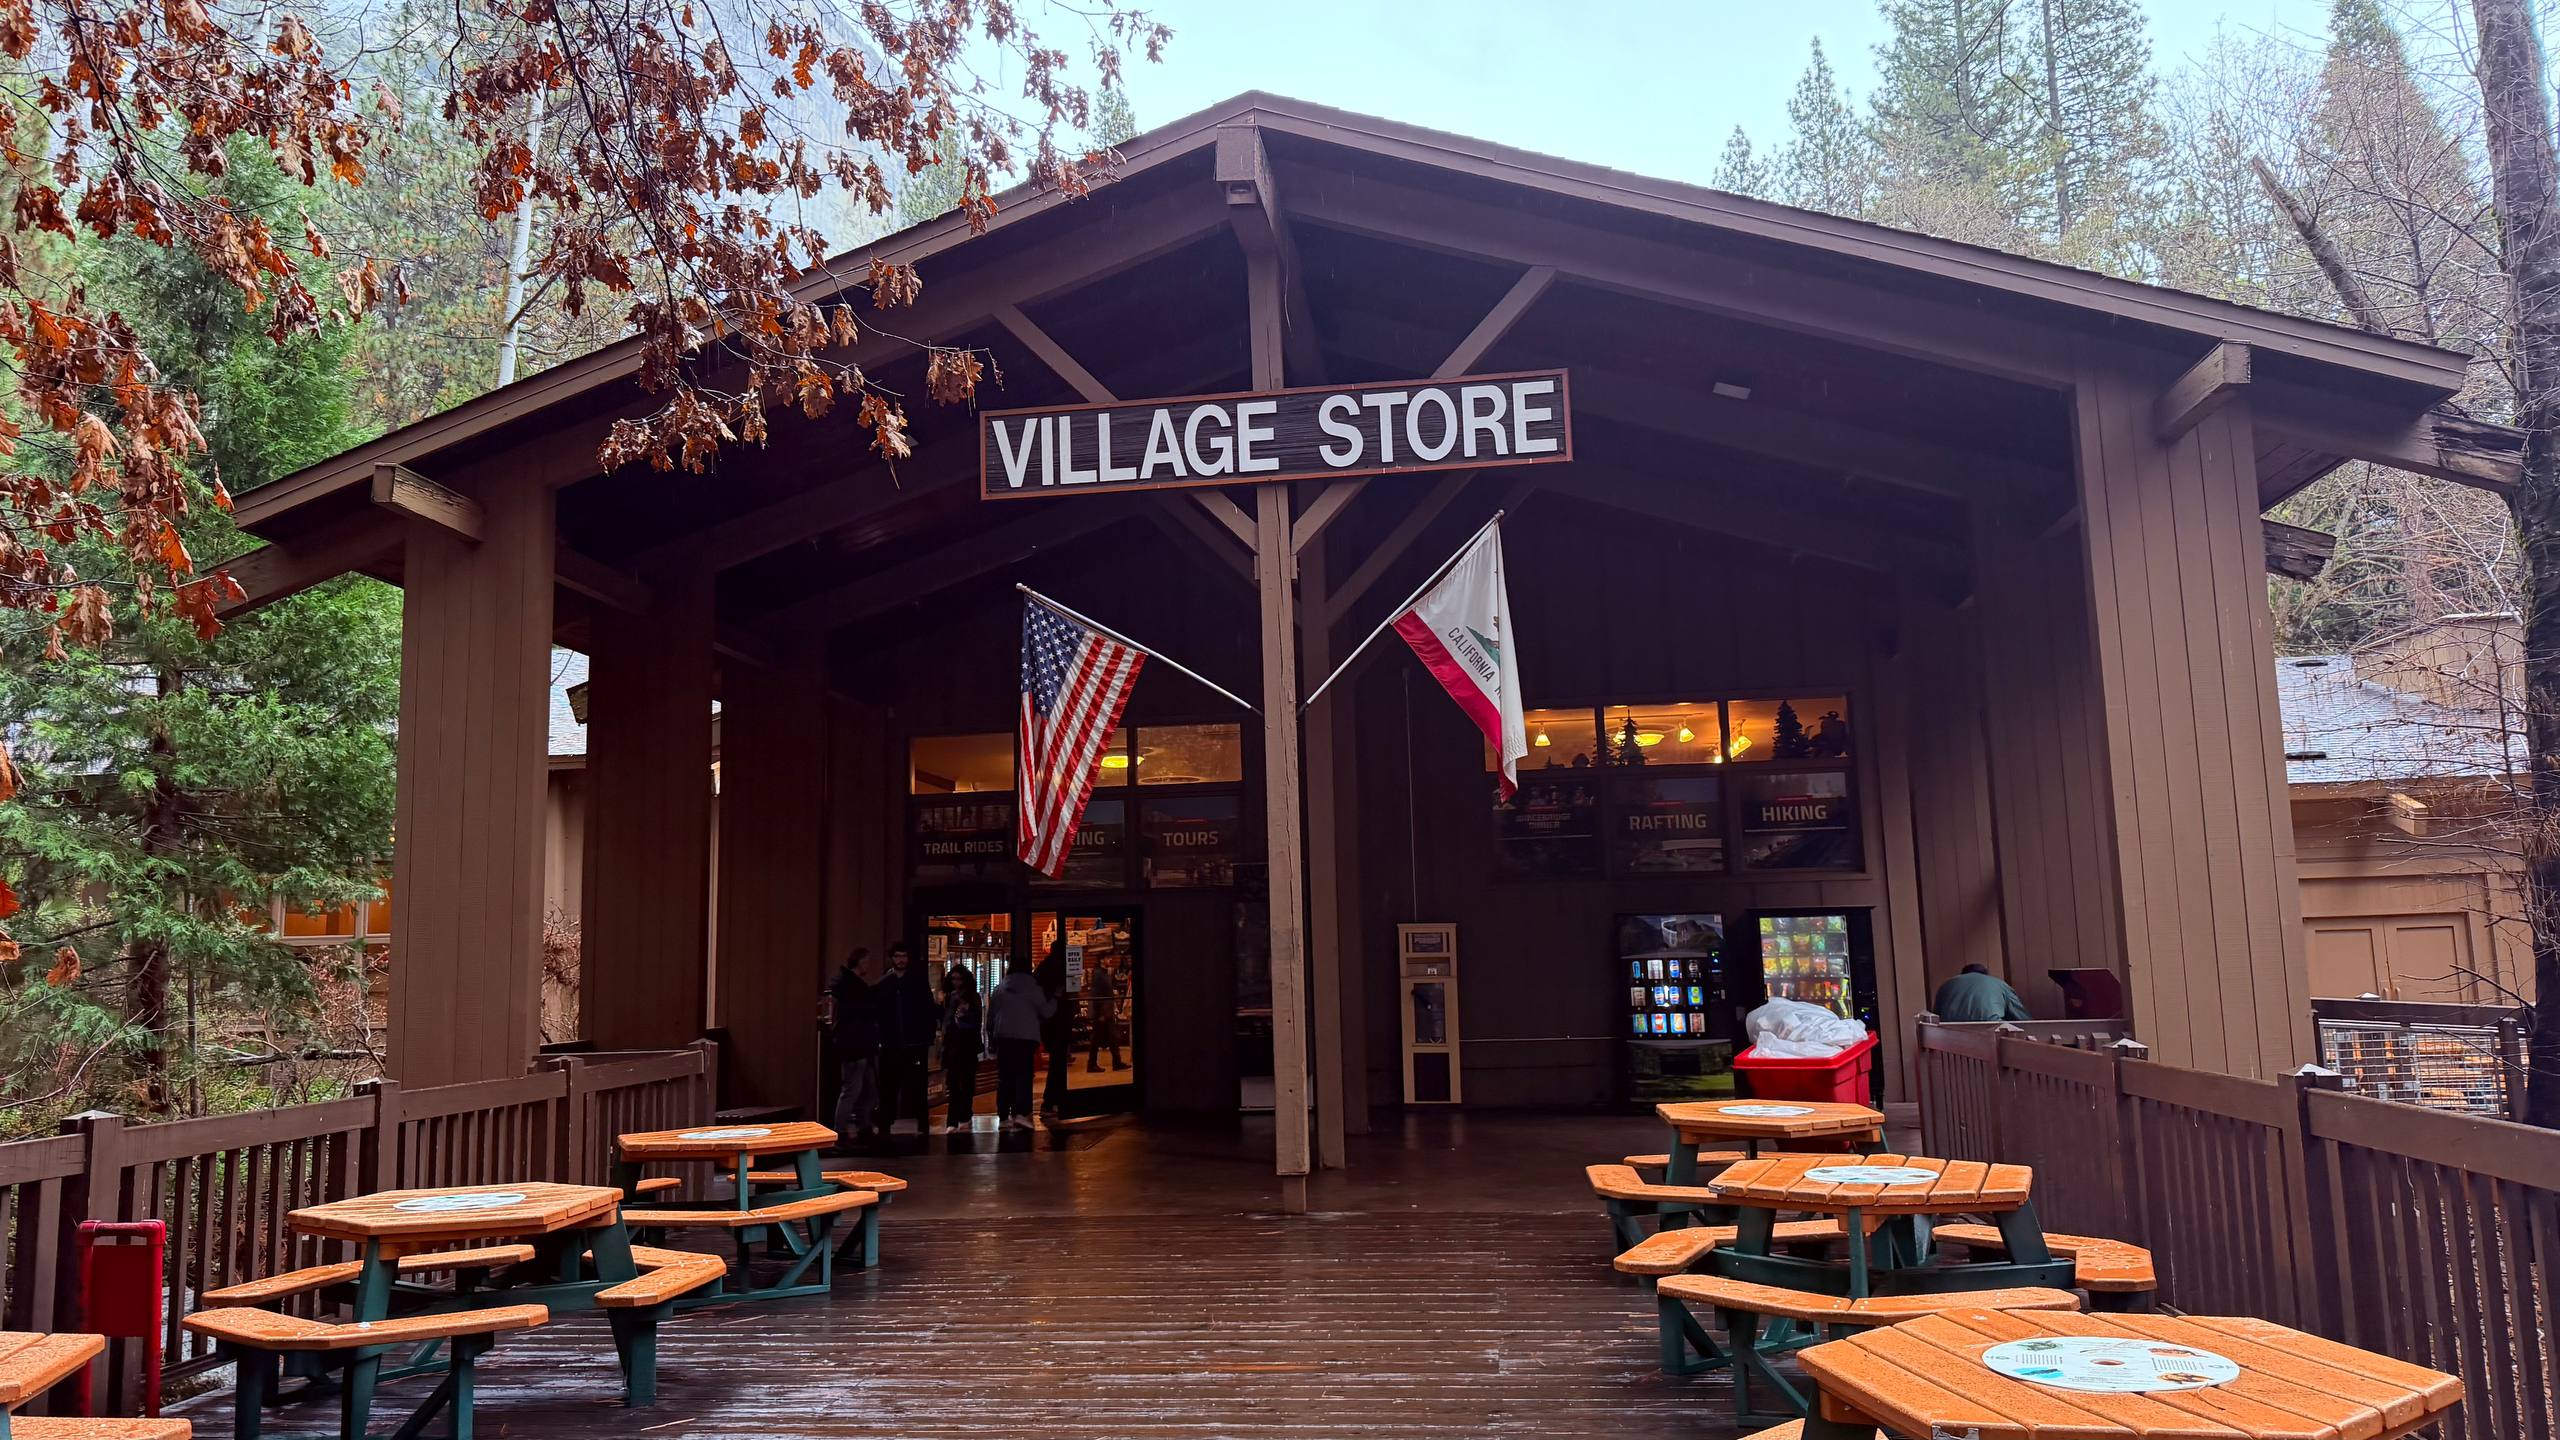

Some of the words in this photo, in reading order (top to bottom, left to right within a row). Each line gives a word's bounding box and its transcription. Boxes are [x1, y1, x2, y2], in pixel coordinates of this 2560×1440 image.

[991, 400, 1280, 488] VILLAGE
[1318, 380, 1558, 468] STORE
[1447, 626, 1496, 683] CALIFORNIA
[1762, 805, 1827, 821] HIKING
[1628, 813, 1707, 830] RAFTING
[1072, 831, 1105, 846] ING
[1162, 831, 1219, 846] TOURS
[923, 841, 961, 855] TRAIL
[964, 840, 1004, 853] RIDES
